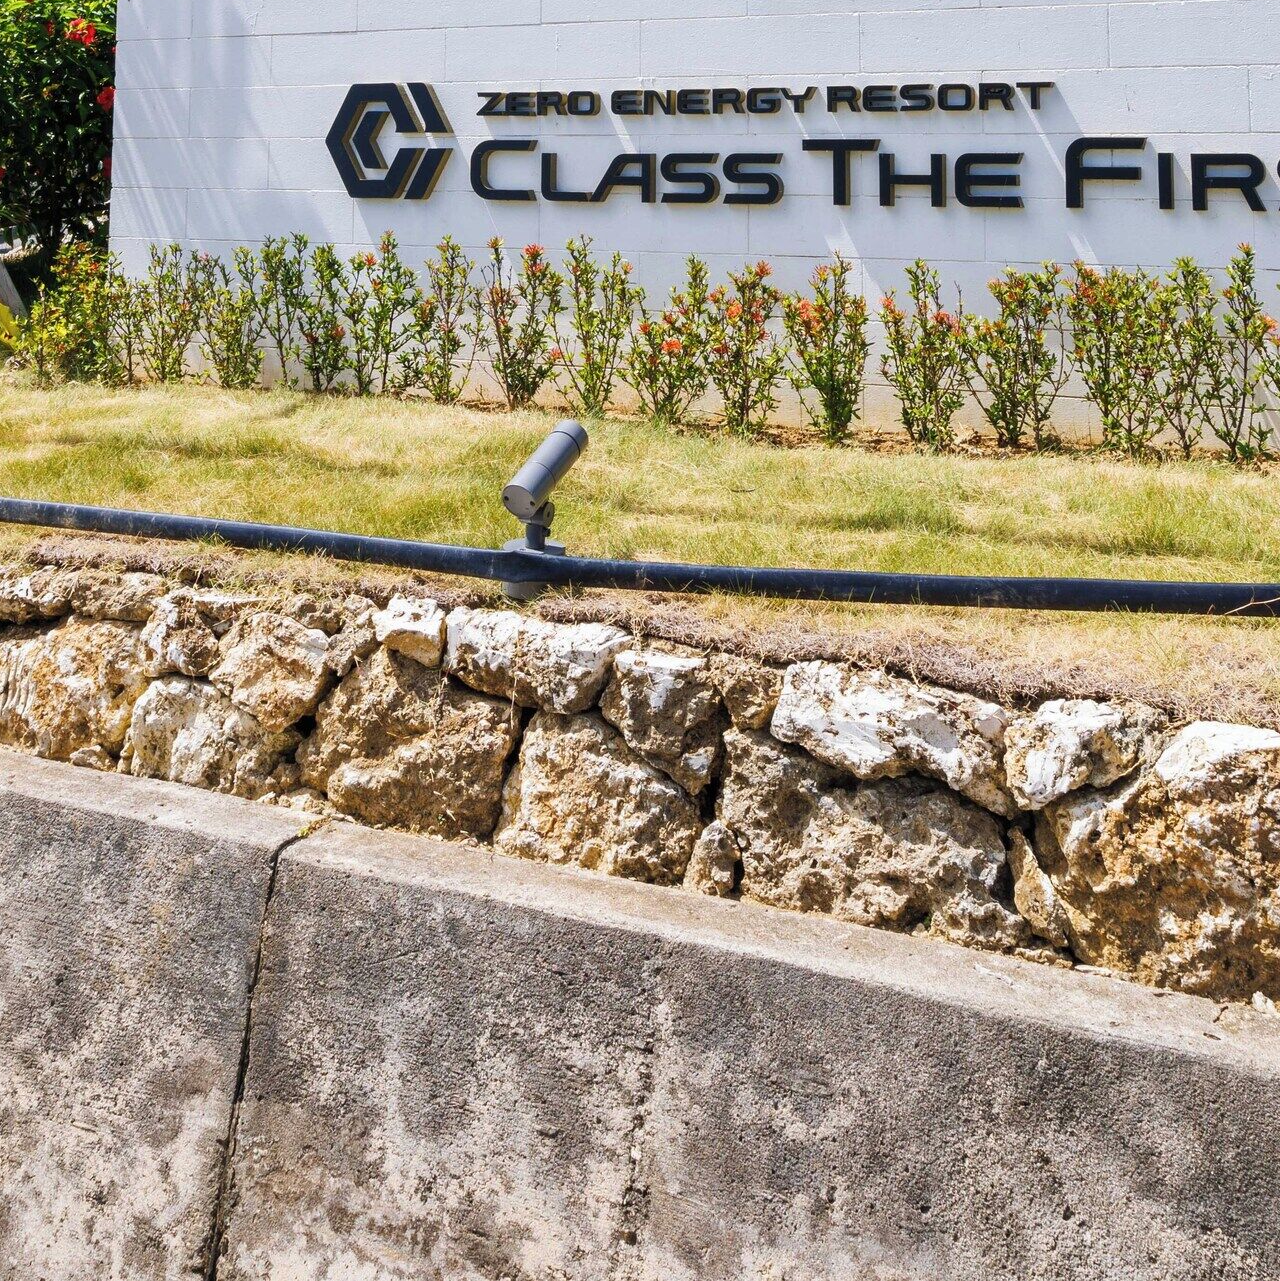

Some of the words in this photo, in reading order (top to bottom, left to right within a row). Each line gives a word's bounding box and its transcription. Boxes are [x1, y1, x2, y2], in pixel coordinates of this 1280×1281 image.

[476, 91, 601, 116] ZERO
[611, 86, 817, 115] ENERGY
[827, 81, 1054, 112] RESORT
[470, 139, 783, 204] CLASS
[802, 138, 1024, 208] THE
